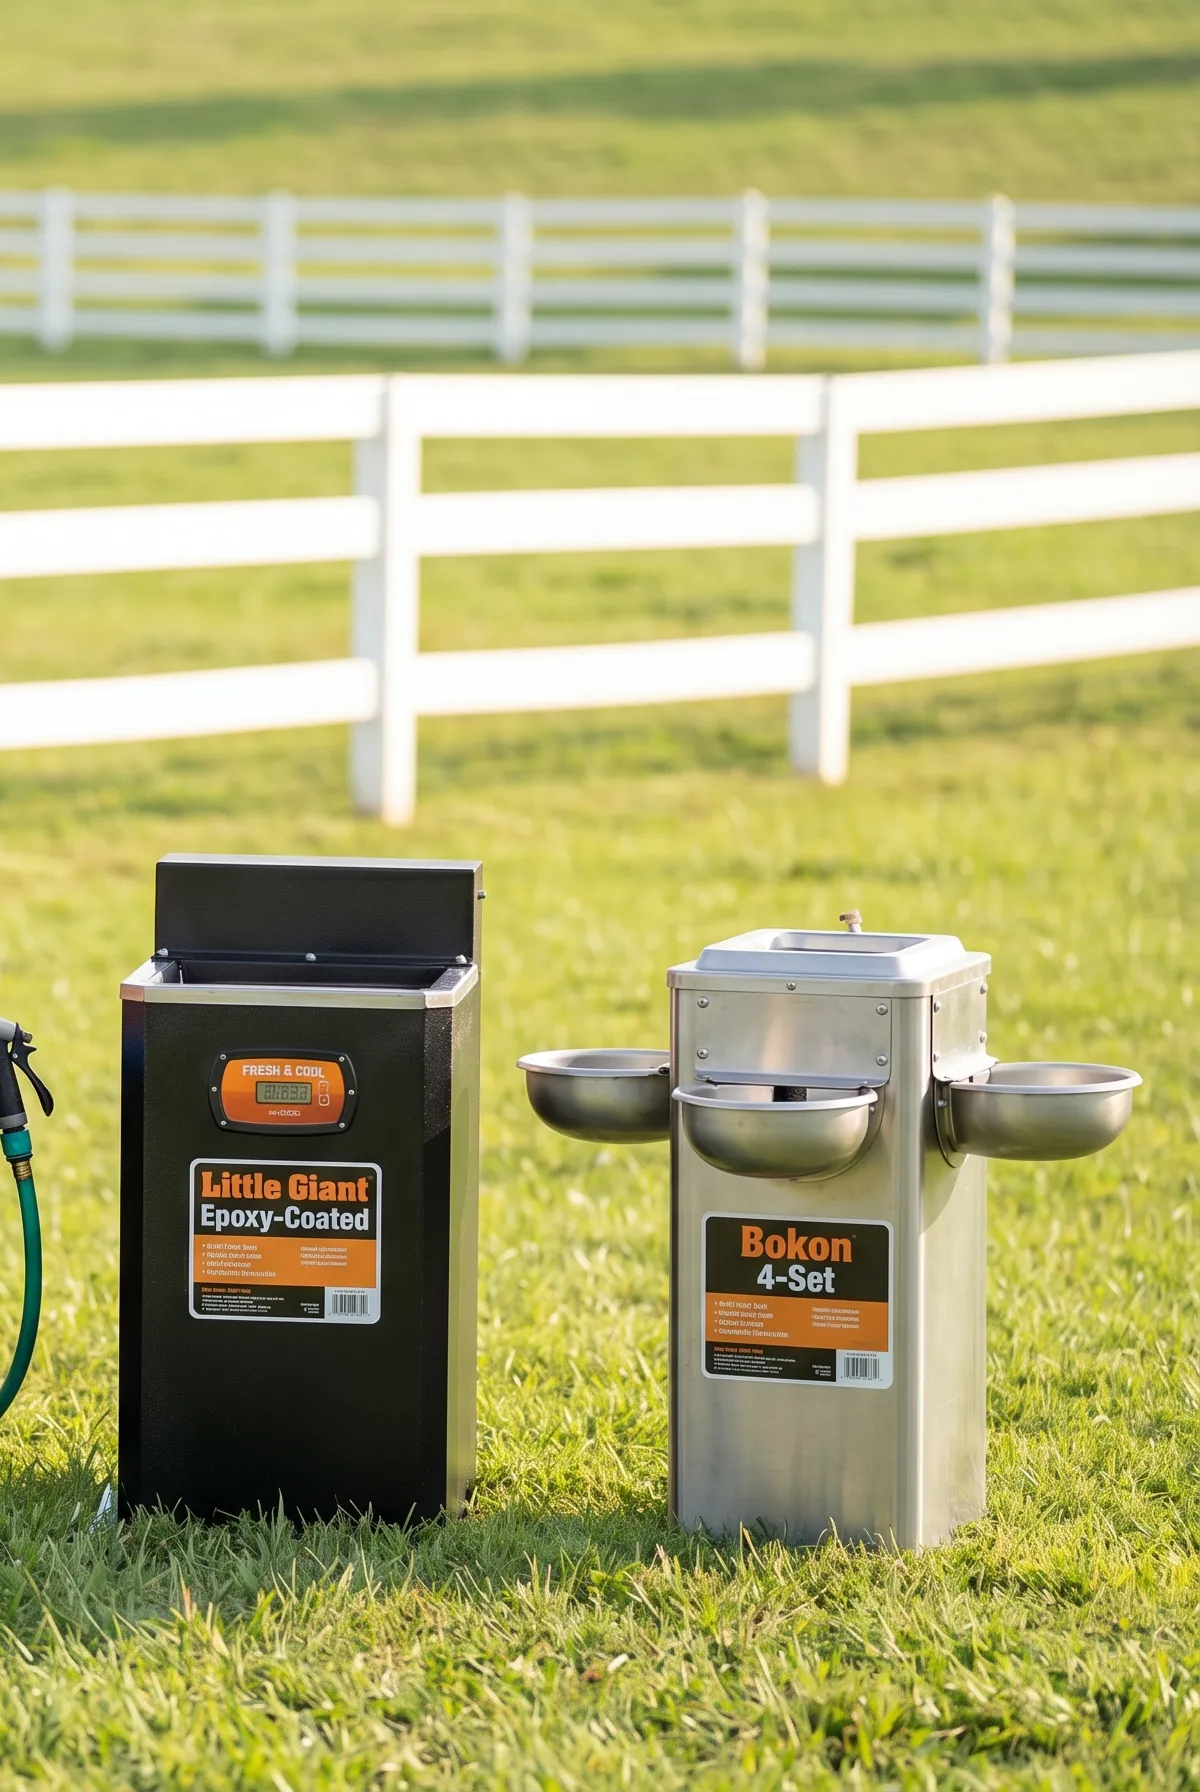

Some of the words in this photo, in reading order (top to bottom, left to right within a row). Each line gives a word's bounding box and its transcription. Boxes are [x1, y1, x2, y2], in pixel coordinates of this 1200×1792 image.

[242, 1065, 281, 1076] FRESH
[283, 1064, 293, 1076] &
[201, 1171, 282, 1200] Little
[288, 1173, 369, 1202] Giant
[201, 1203, 369, 1233] Epoxy-Coated
[740, 1225, 853, 1262] Bokon
[756, 1263, 836, 1293] 4-Set
